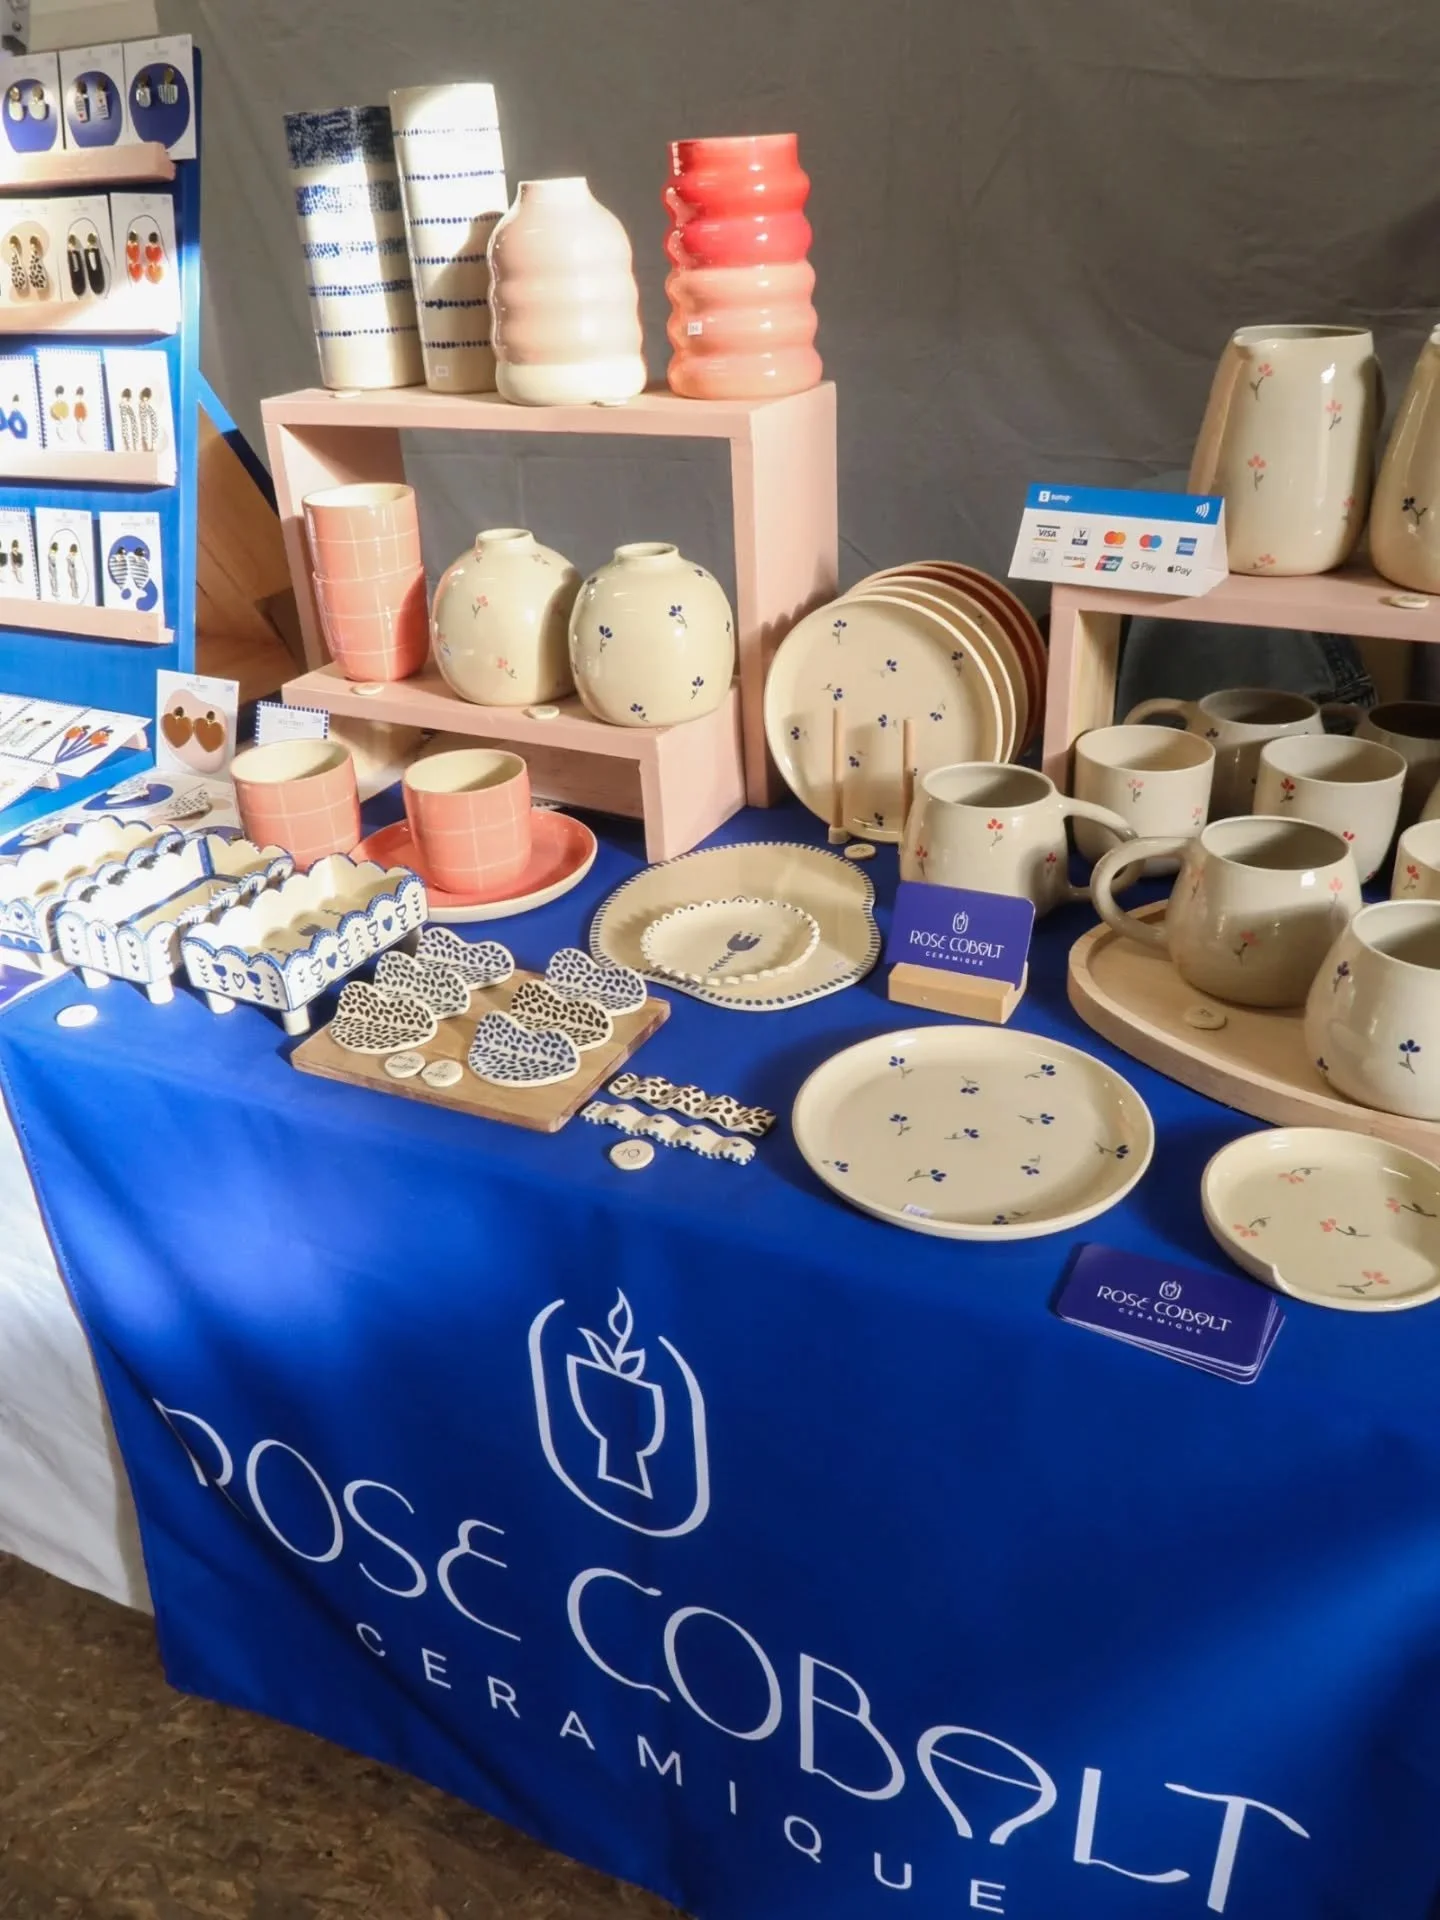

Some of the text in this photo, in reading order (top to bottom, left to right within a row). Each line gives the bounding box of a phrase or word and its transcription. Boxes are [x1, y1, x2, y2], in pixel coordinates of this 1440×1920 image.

[1038, 529, 1057, 538] VISA
[1140, 561, 1157, 574] Pay
[1174, 565, 1193, 577] Pay
[909, 929, 948, 950] ROSE
[925, 950, 984, 967] CERAMIQUE
[1096, 1285, 1150, 1311] ROSE
[1118, 1307, 1202, 1335] CERAMIQUE
[566, 1566, 1311, 1914] COBALT
[356, 1622, 1007, 1915] CERAMIQUE
